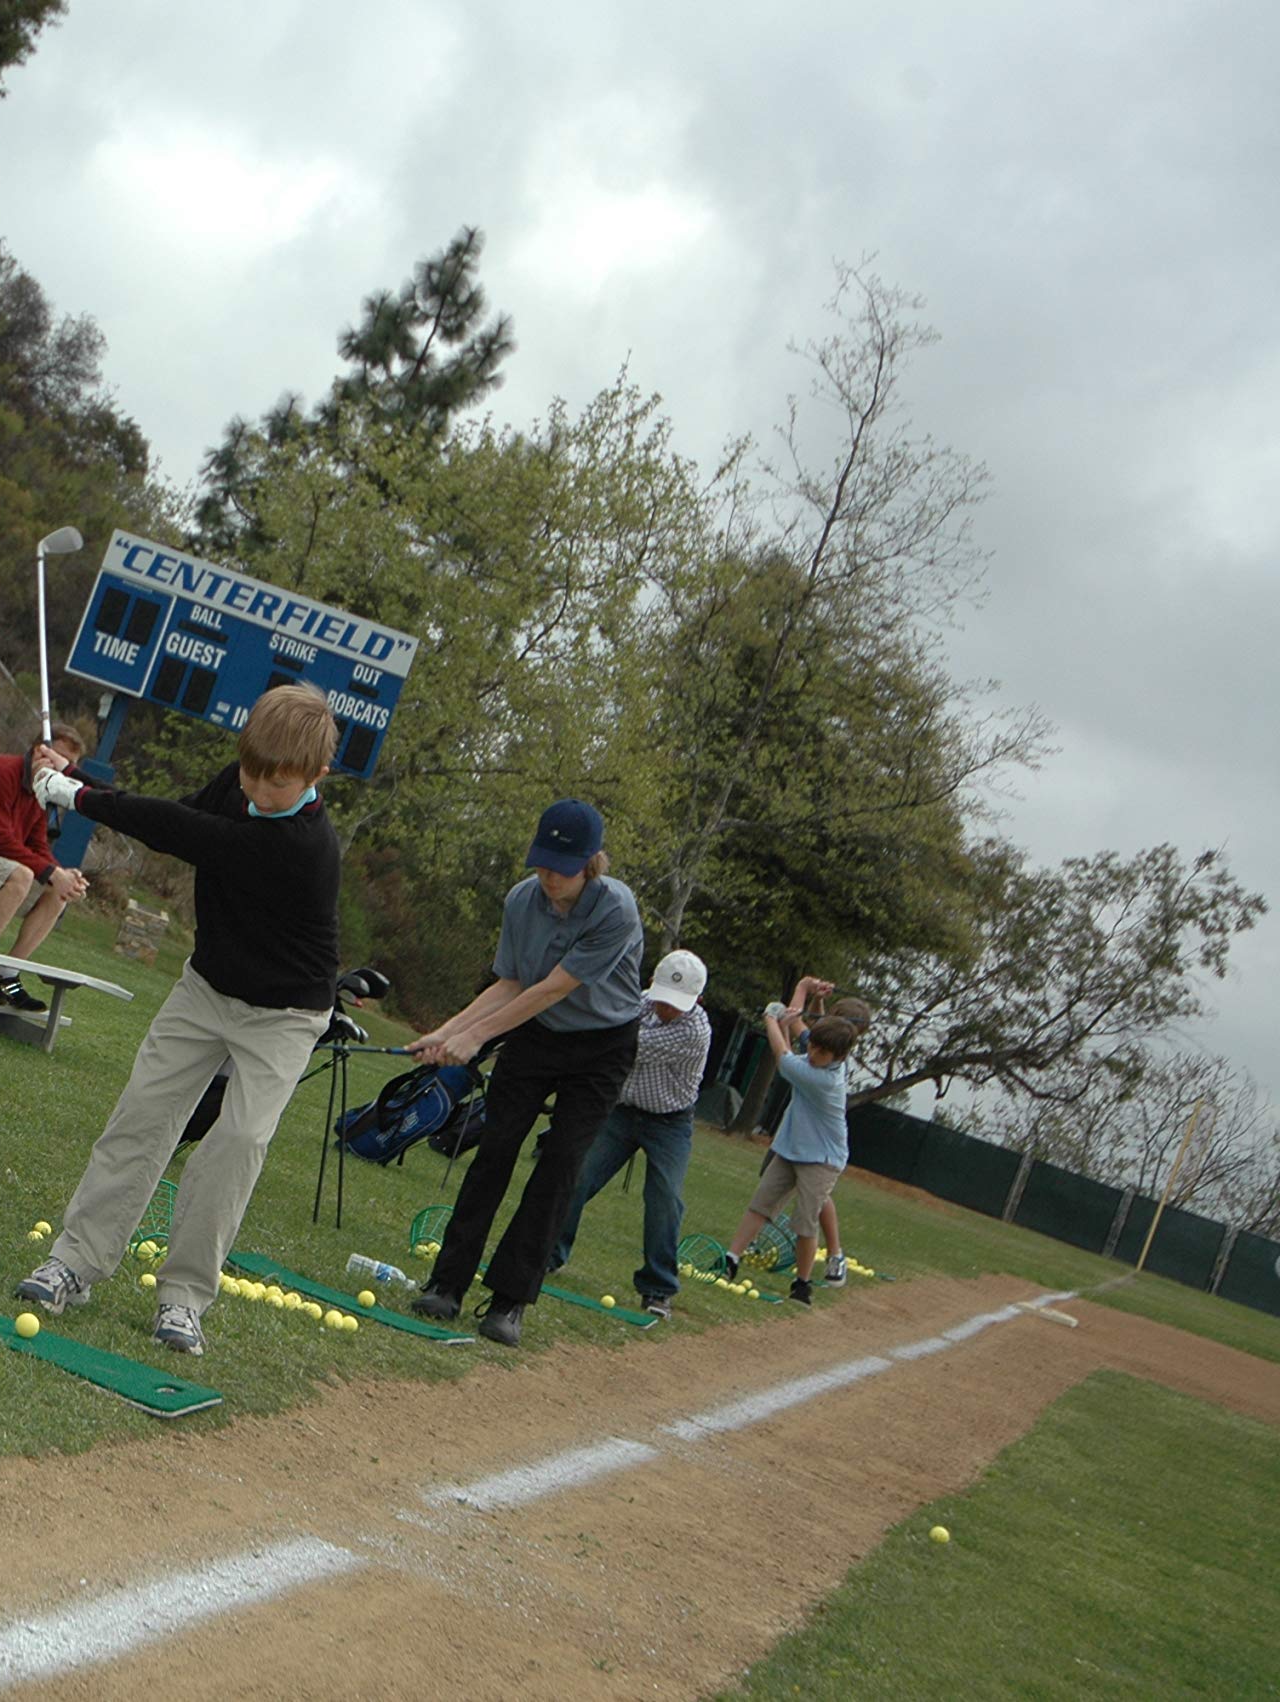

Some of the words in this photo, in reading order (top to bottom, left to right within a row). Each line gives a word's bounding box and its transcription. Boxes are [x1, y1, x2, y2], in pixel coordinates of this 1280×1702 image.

[190, 604, 222, 630] BALL
[93, 631, 140, 666] TIME
[165, 632, 227, 669] GUEST
[269, 633, 318, 664] STRIKE
[353, 664, 384, 686] OUT
[327, 690, 390, 729] BOBCATS
